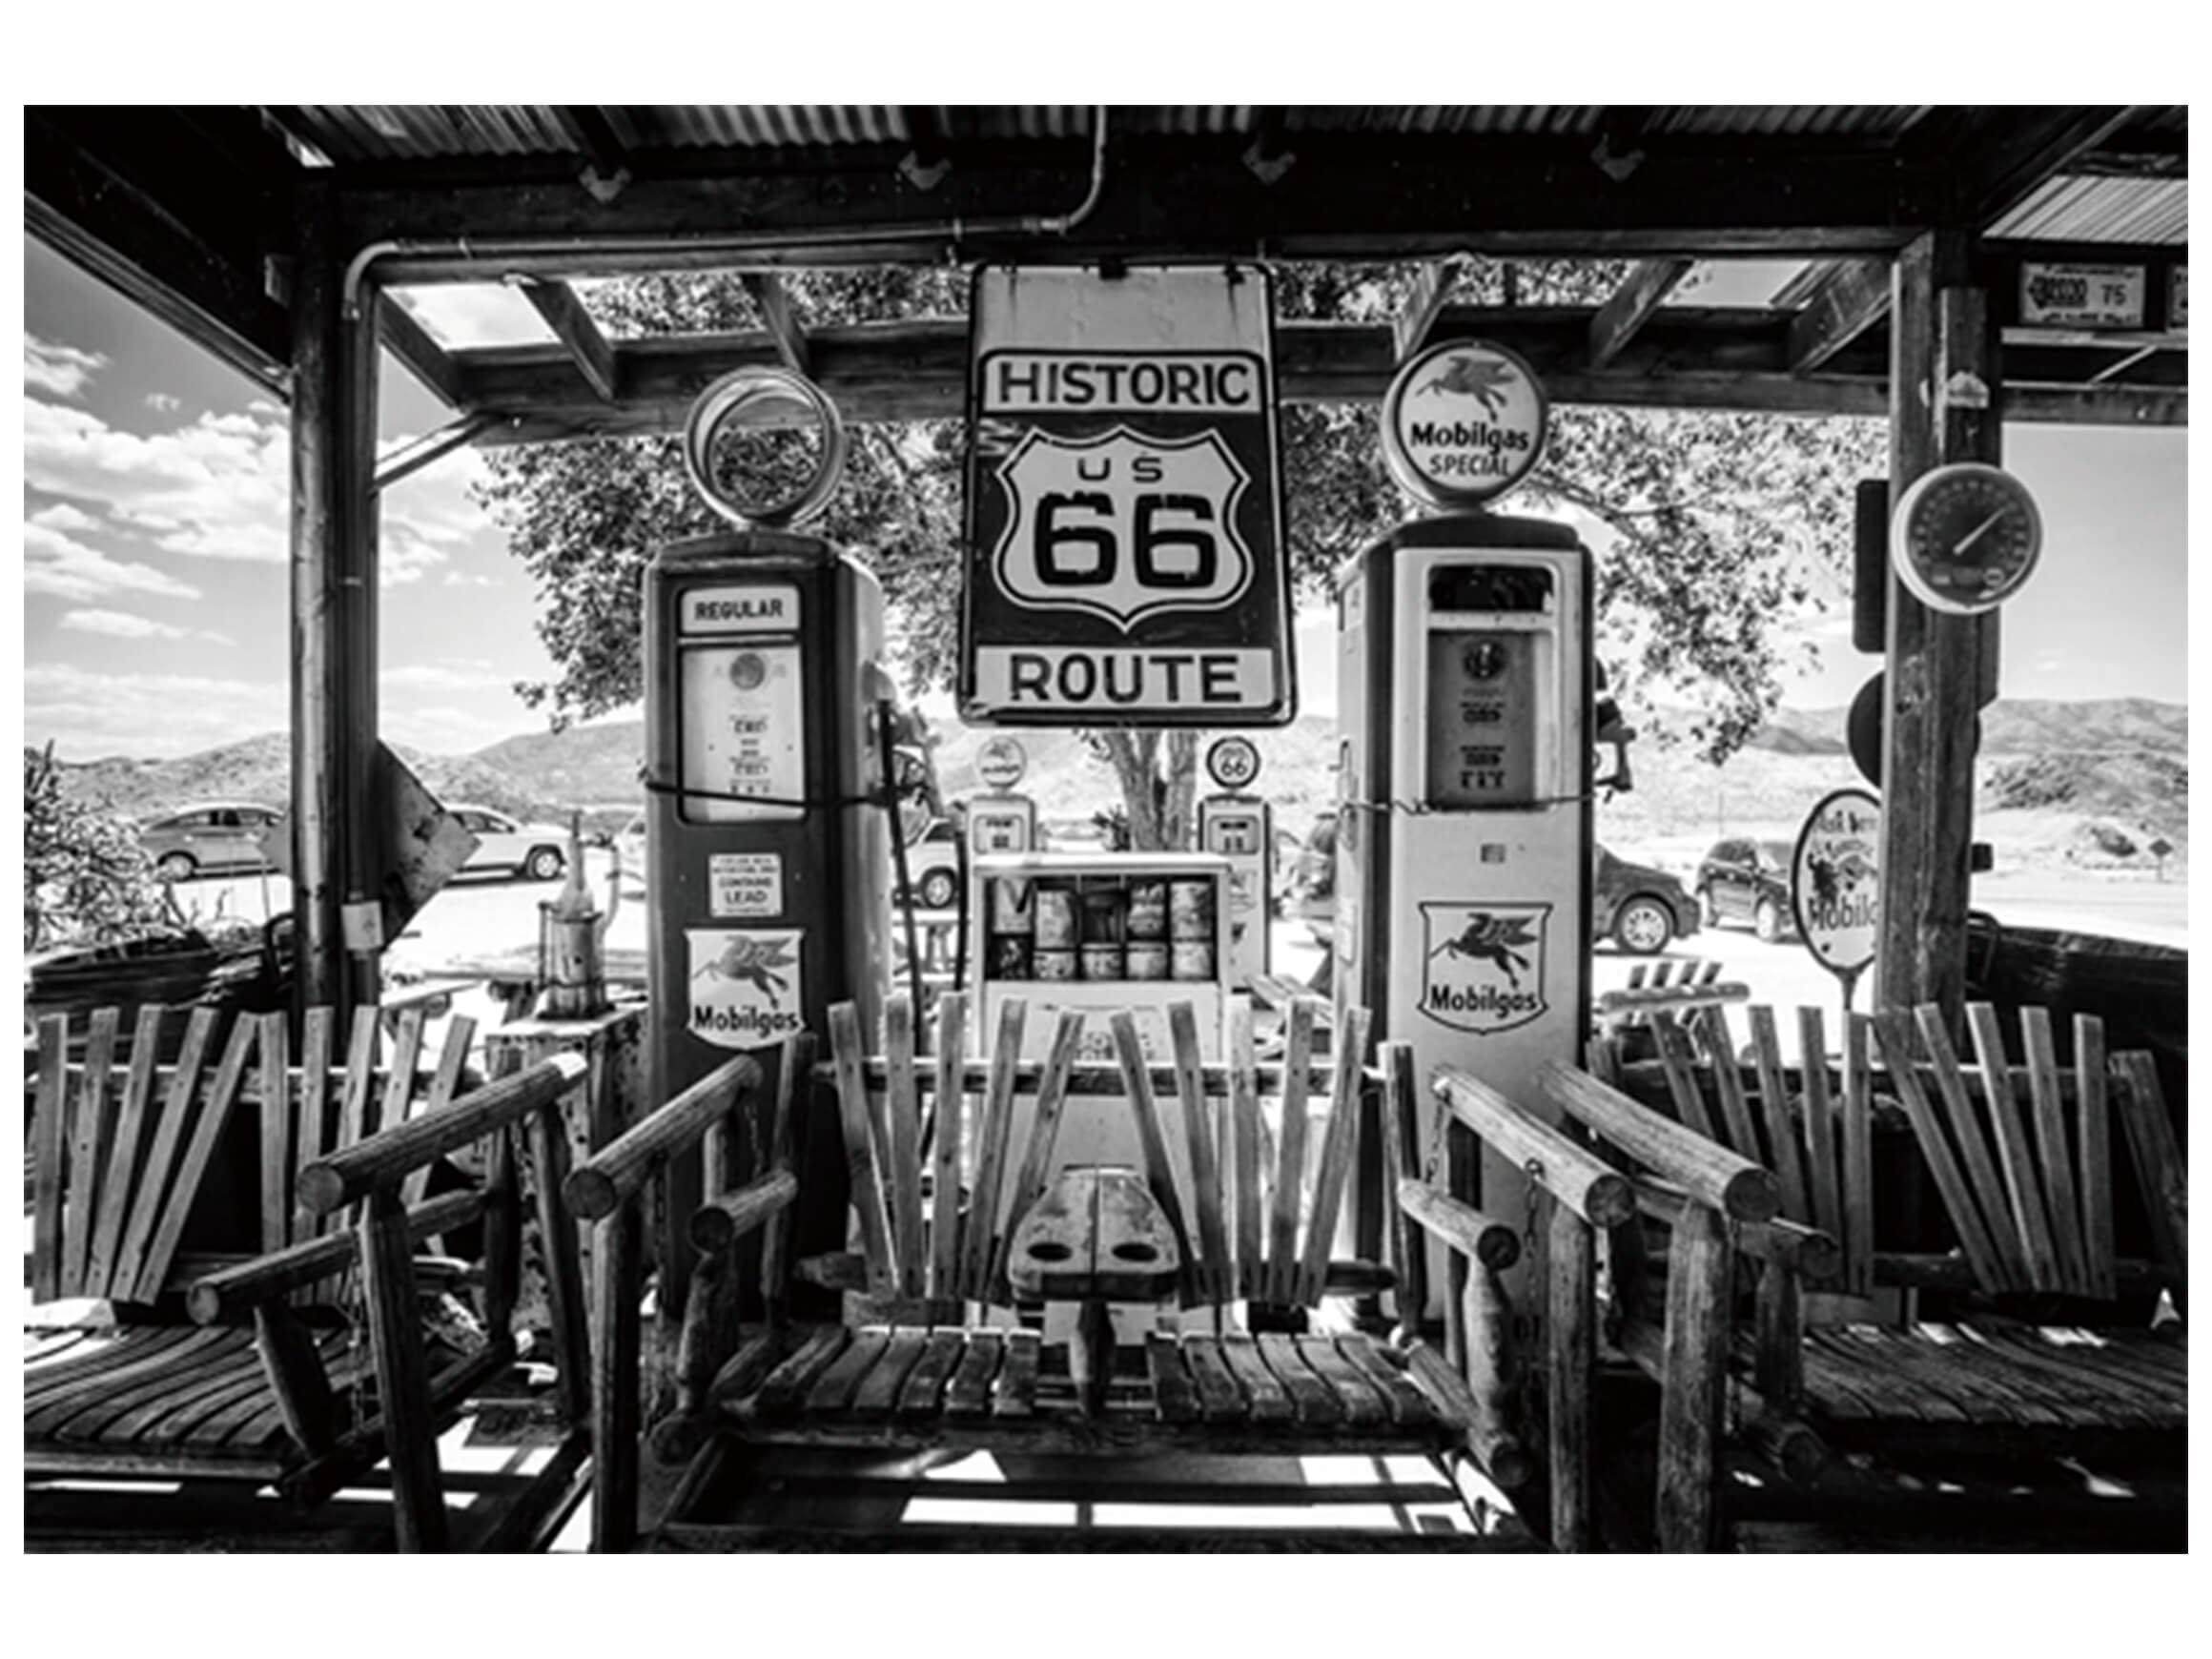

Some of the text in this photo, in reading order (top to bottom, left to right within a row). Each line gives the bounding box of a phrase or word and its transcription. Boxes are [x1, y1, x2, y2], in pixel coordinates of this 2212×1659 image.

[999, 362, 1251, 405] HISTORIC
[1411, 420, 1530, 454] Mobilgas
[1430, 455, 1510, 476] SPECIAL
[1033, 490, 1218, 589] 66
[695, 599, 784, 620] REGULAR
[1009, 652, 1243, 703] ROUTE
[725, 890, 768, 905] LEAD
[1431, 983, 1537, 1019] Mobilgas
[694, 1004, 799, 1039] Mobilgas
